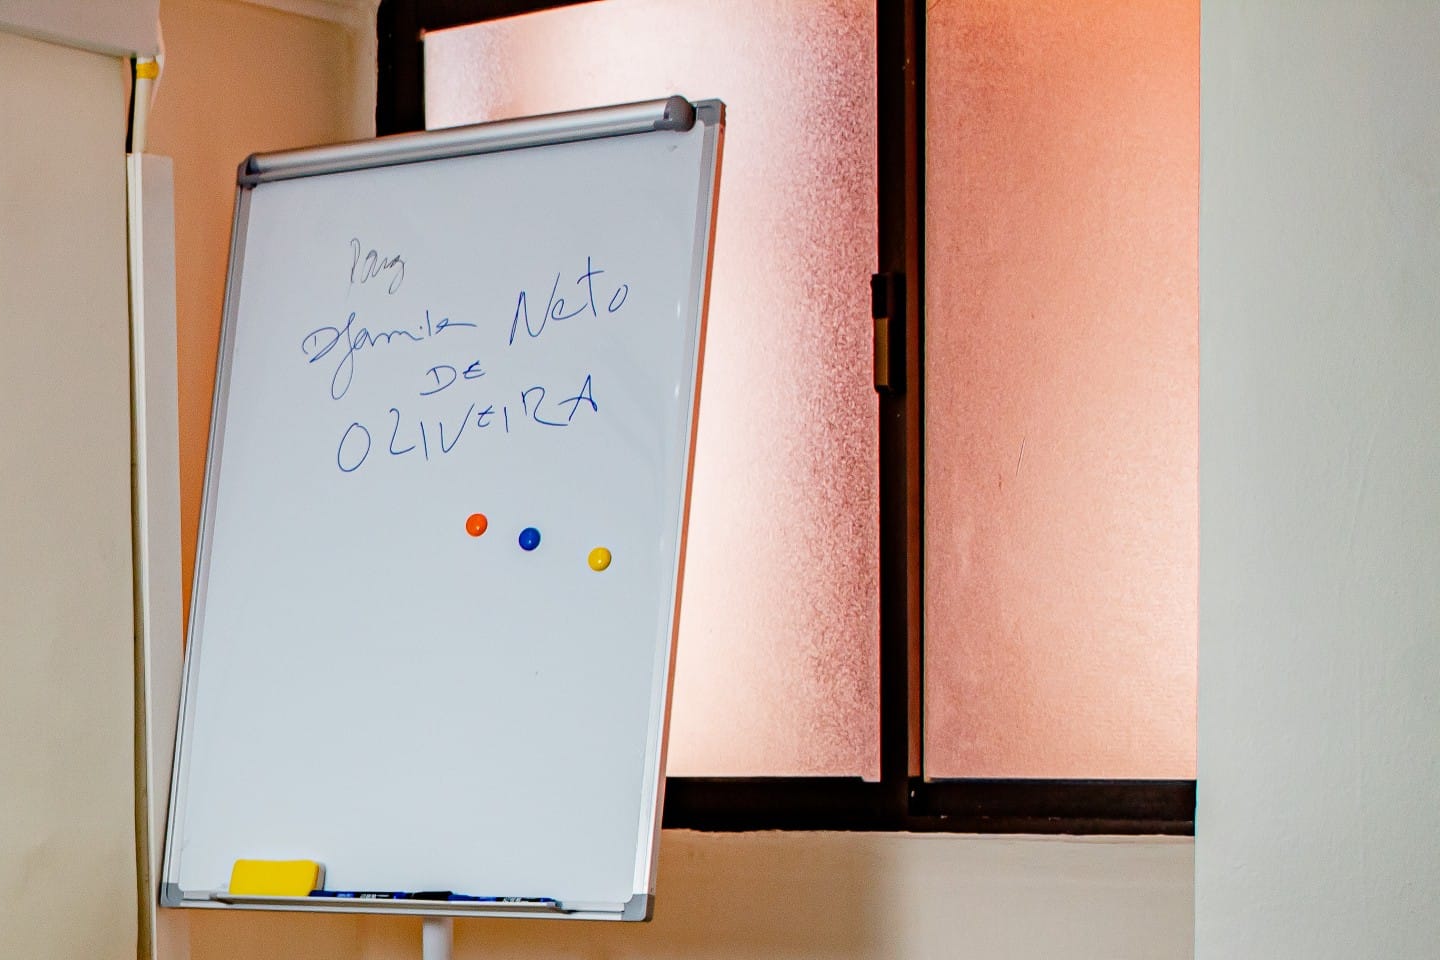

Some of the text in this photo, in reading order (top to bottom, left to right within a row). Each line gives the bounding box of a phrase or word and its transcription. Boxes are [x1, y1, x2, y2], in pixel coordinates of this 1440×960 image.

[509, 255, 629, 346] Neto
[337, 374, 598, 473] OLIVEIRA
[419, 360, 486, 396] DE
